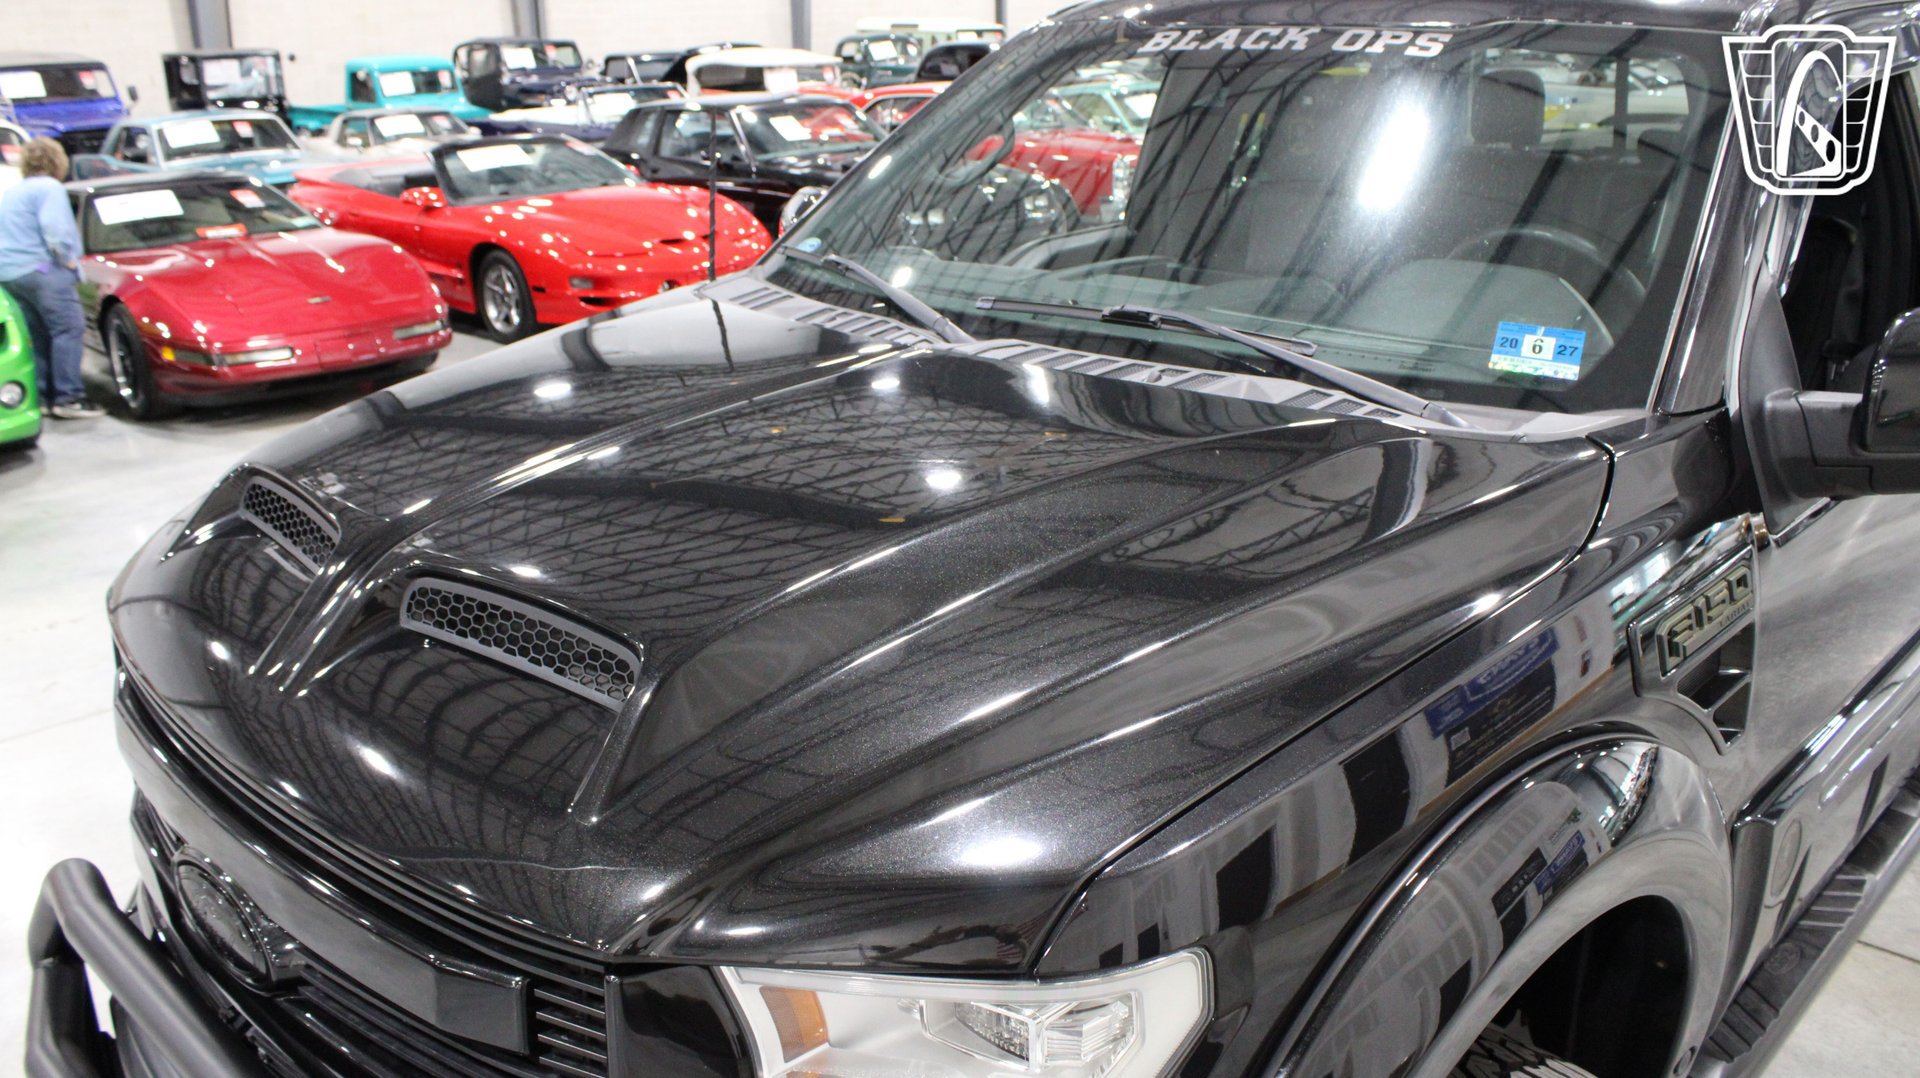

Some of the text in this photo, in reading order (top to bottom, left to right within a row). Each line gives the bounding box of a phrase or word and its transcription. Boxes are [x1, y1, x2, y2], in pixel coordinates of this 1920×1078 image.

[1137, 27, 1453, 58] BLACK OPS
[1500, 336, 1579, 357] 20 6 27
